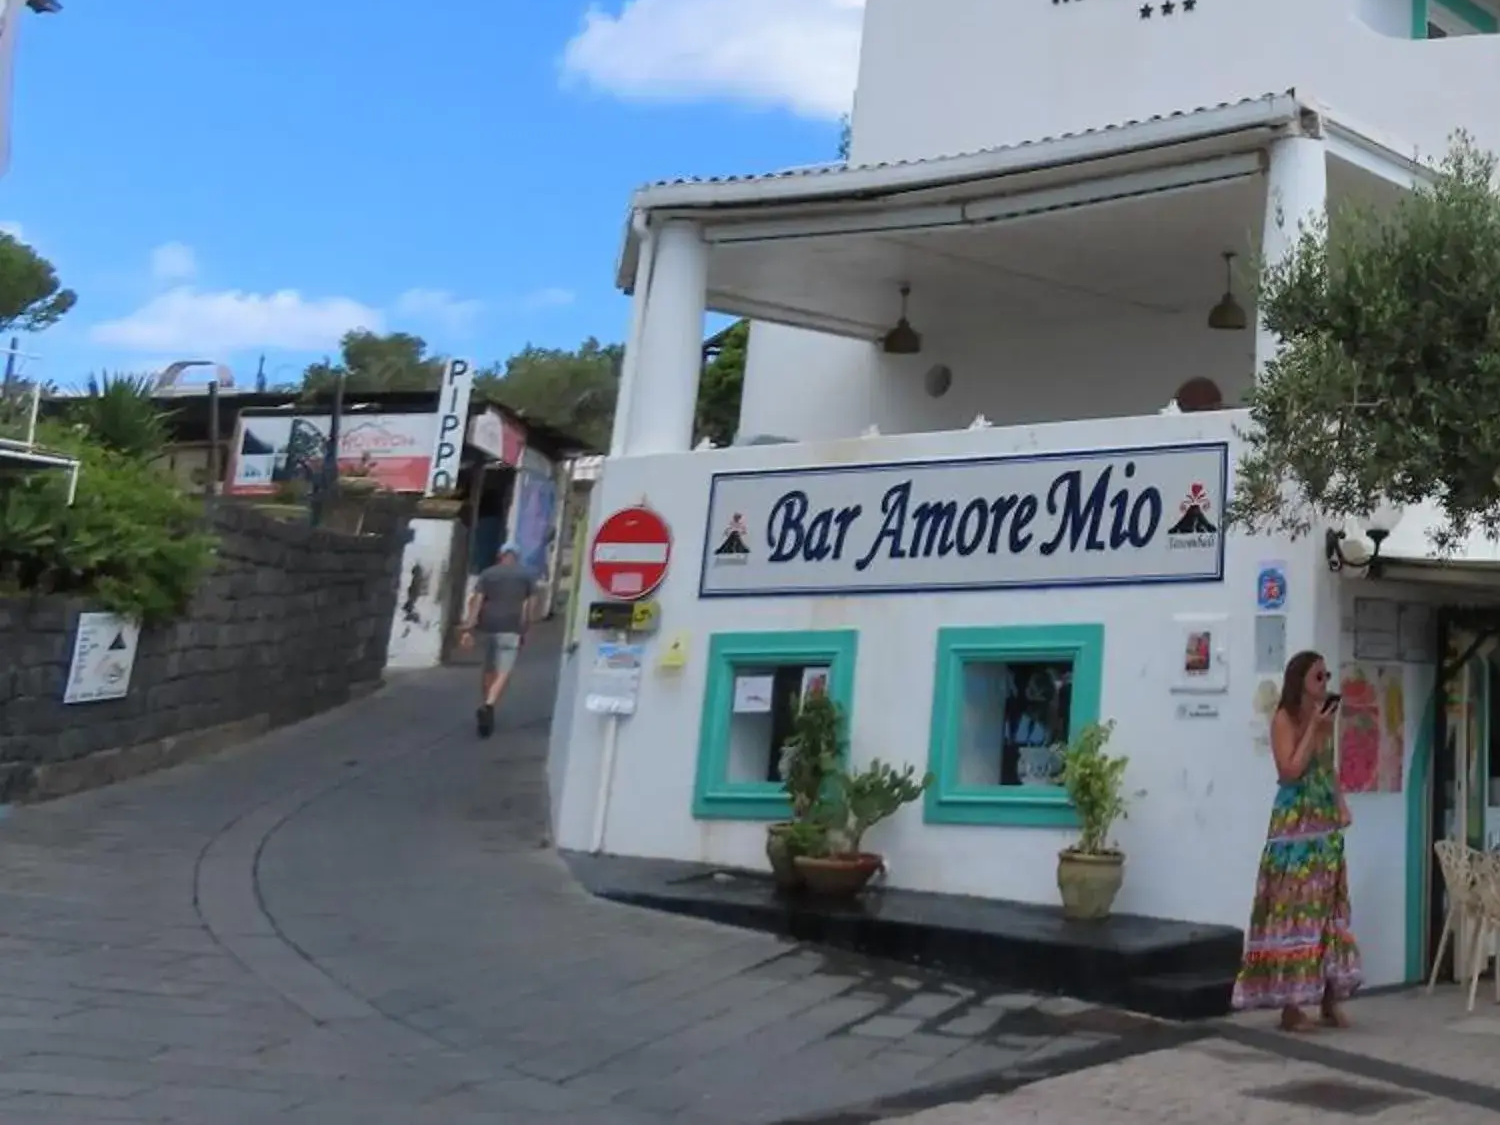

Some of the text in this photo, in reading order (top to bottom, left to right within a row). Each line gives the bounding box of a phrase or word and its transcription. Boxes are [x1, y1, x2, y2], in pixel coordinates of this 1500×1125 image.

[432, 360, 468, 494] PIPPO
[767, 462, 1162, 571] Bar Amore Mio
